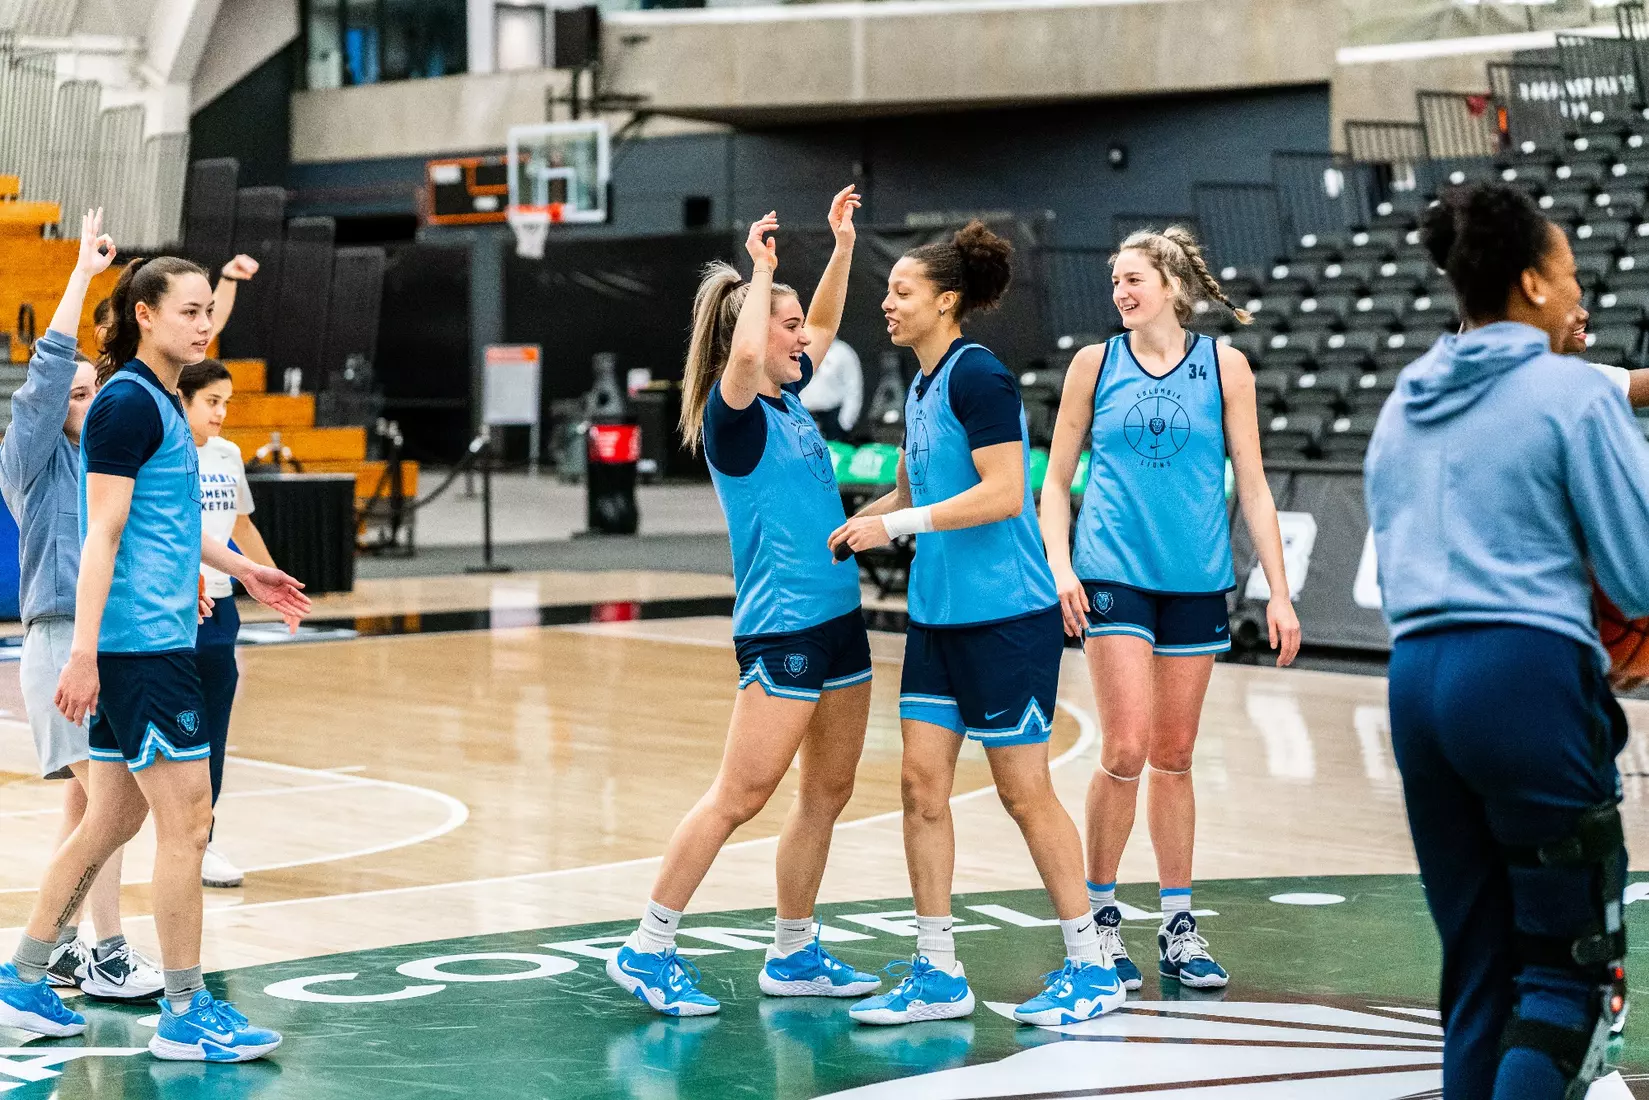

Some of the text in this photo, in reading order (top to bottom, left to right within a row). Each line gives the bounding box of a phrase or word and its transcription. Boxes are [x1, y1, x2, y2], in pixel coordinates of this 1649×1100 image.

[1188, 363, 1207, 381] 34
[1136, 387, 1182, 400] COLUMBIA
[1140, 460, 1171, 469] LIONS
[200, 489, 236, 499] OMEN'S
[201, 501, 237, 511] KETBA
